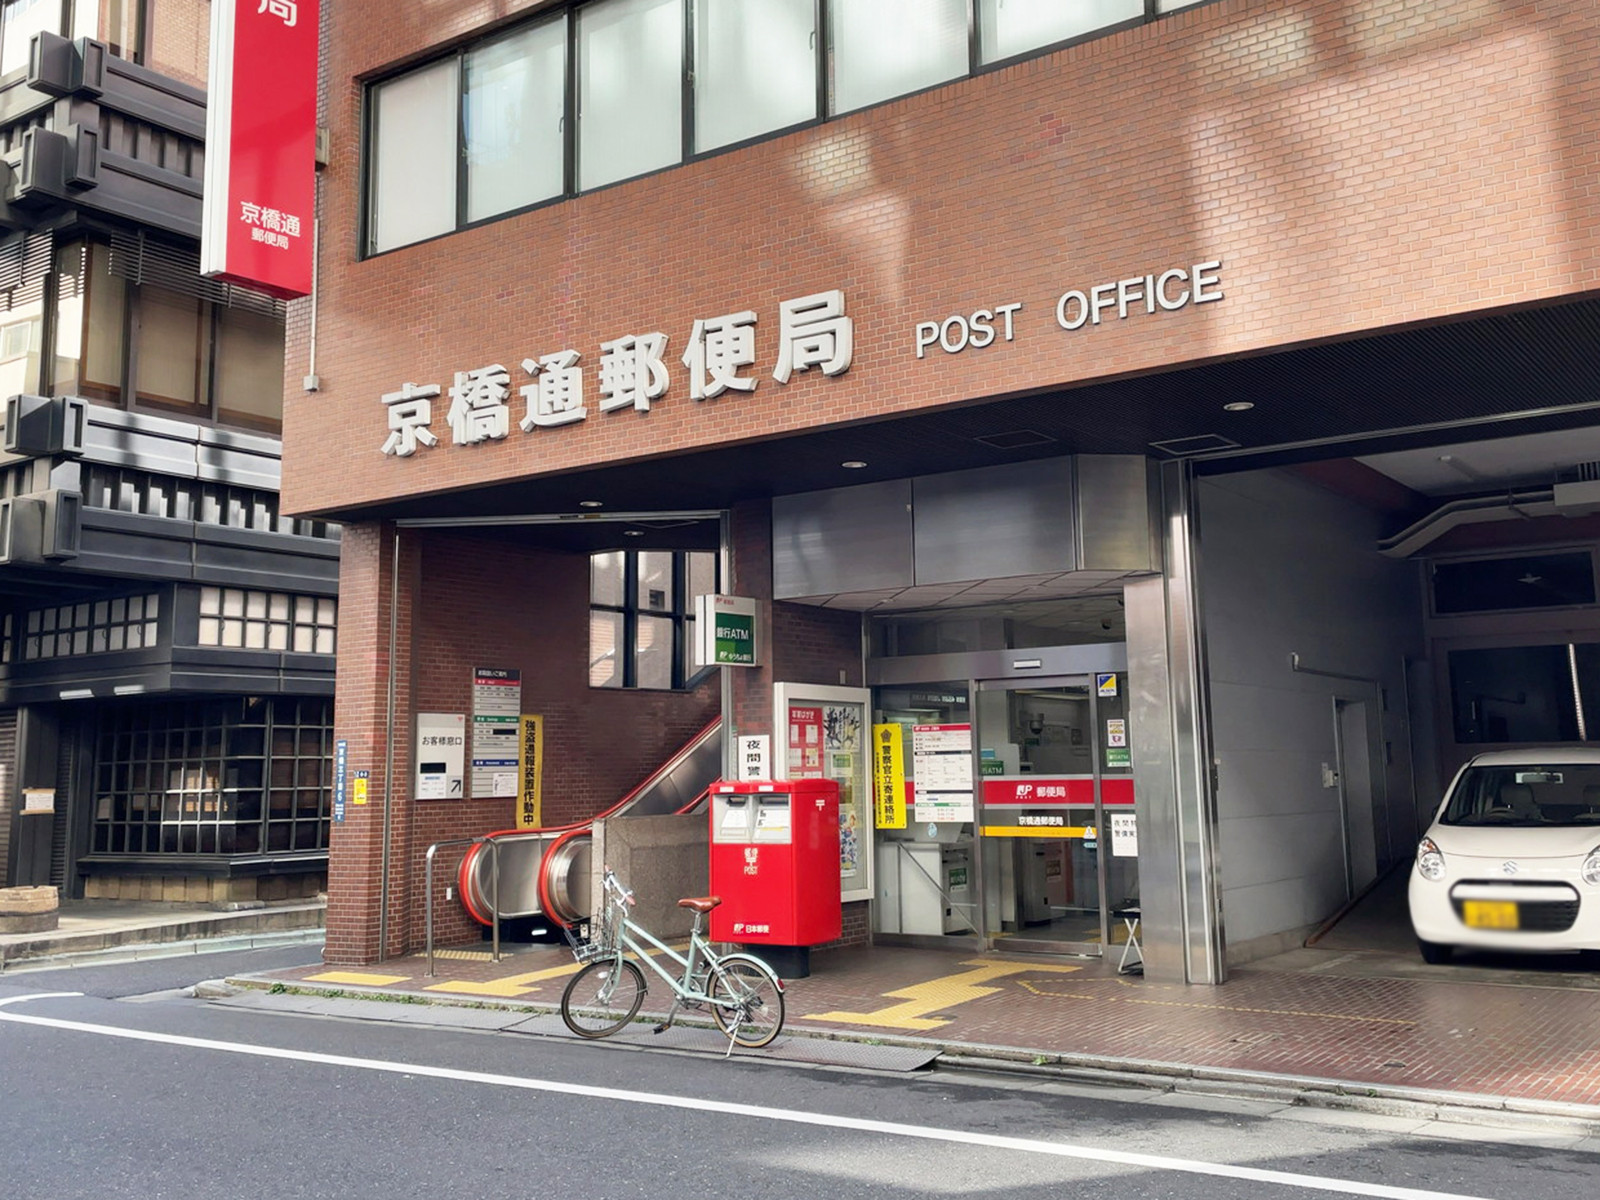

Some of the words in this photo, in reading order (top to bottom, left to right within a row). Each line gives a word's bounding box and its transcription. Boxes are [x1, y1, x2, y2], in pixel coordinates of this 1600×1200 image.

[240, 201, 302, 238] 京橋通
[251, 227, 290, 250] 郵便局
[916, 302, 1023, 359] POST
[1056, 259, 1224, 332] OFFICE
[380, 289, 854, 457] 京橋通郵便局
[716, 626, 750, 641] 銀行ATM
[422, 735, 463, 747] お客様窓口
[524, 720, 535, 825] 強盗通報装置作動中
[882, 745, 895, 825] 警察官立寄連絡所
[1036, 786, 1067, 799] 郵便局
[1018, 816, 1064, 827] 京橋通郵便局
[743, 866, 759, 876] POST
[745, 924, 770, 934] 日本郵便
